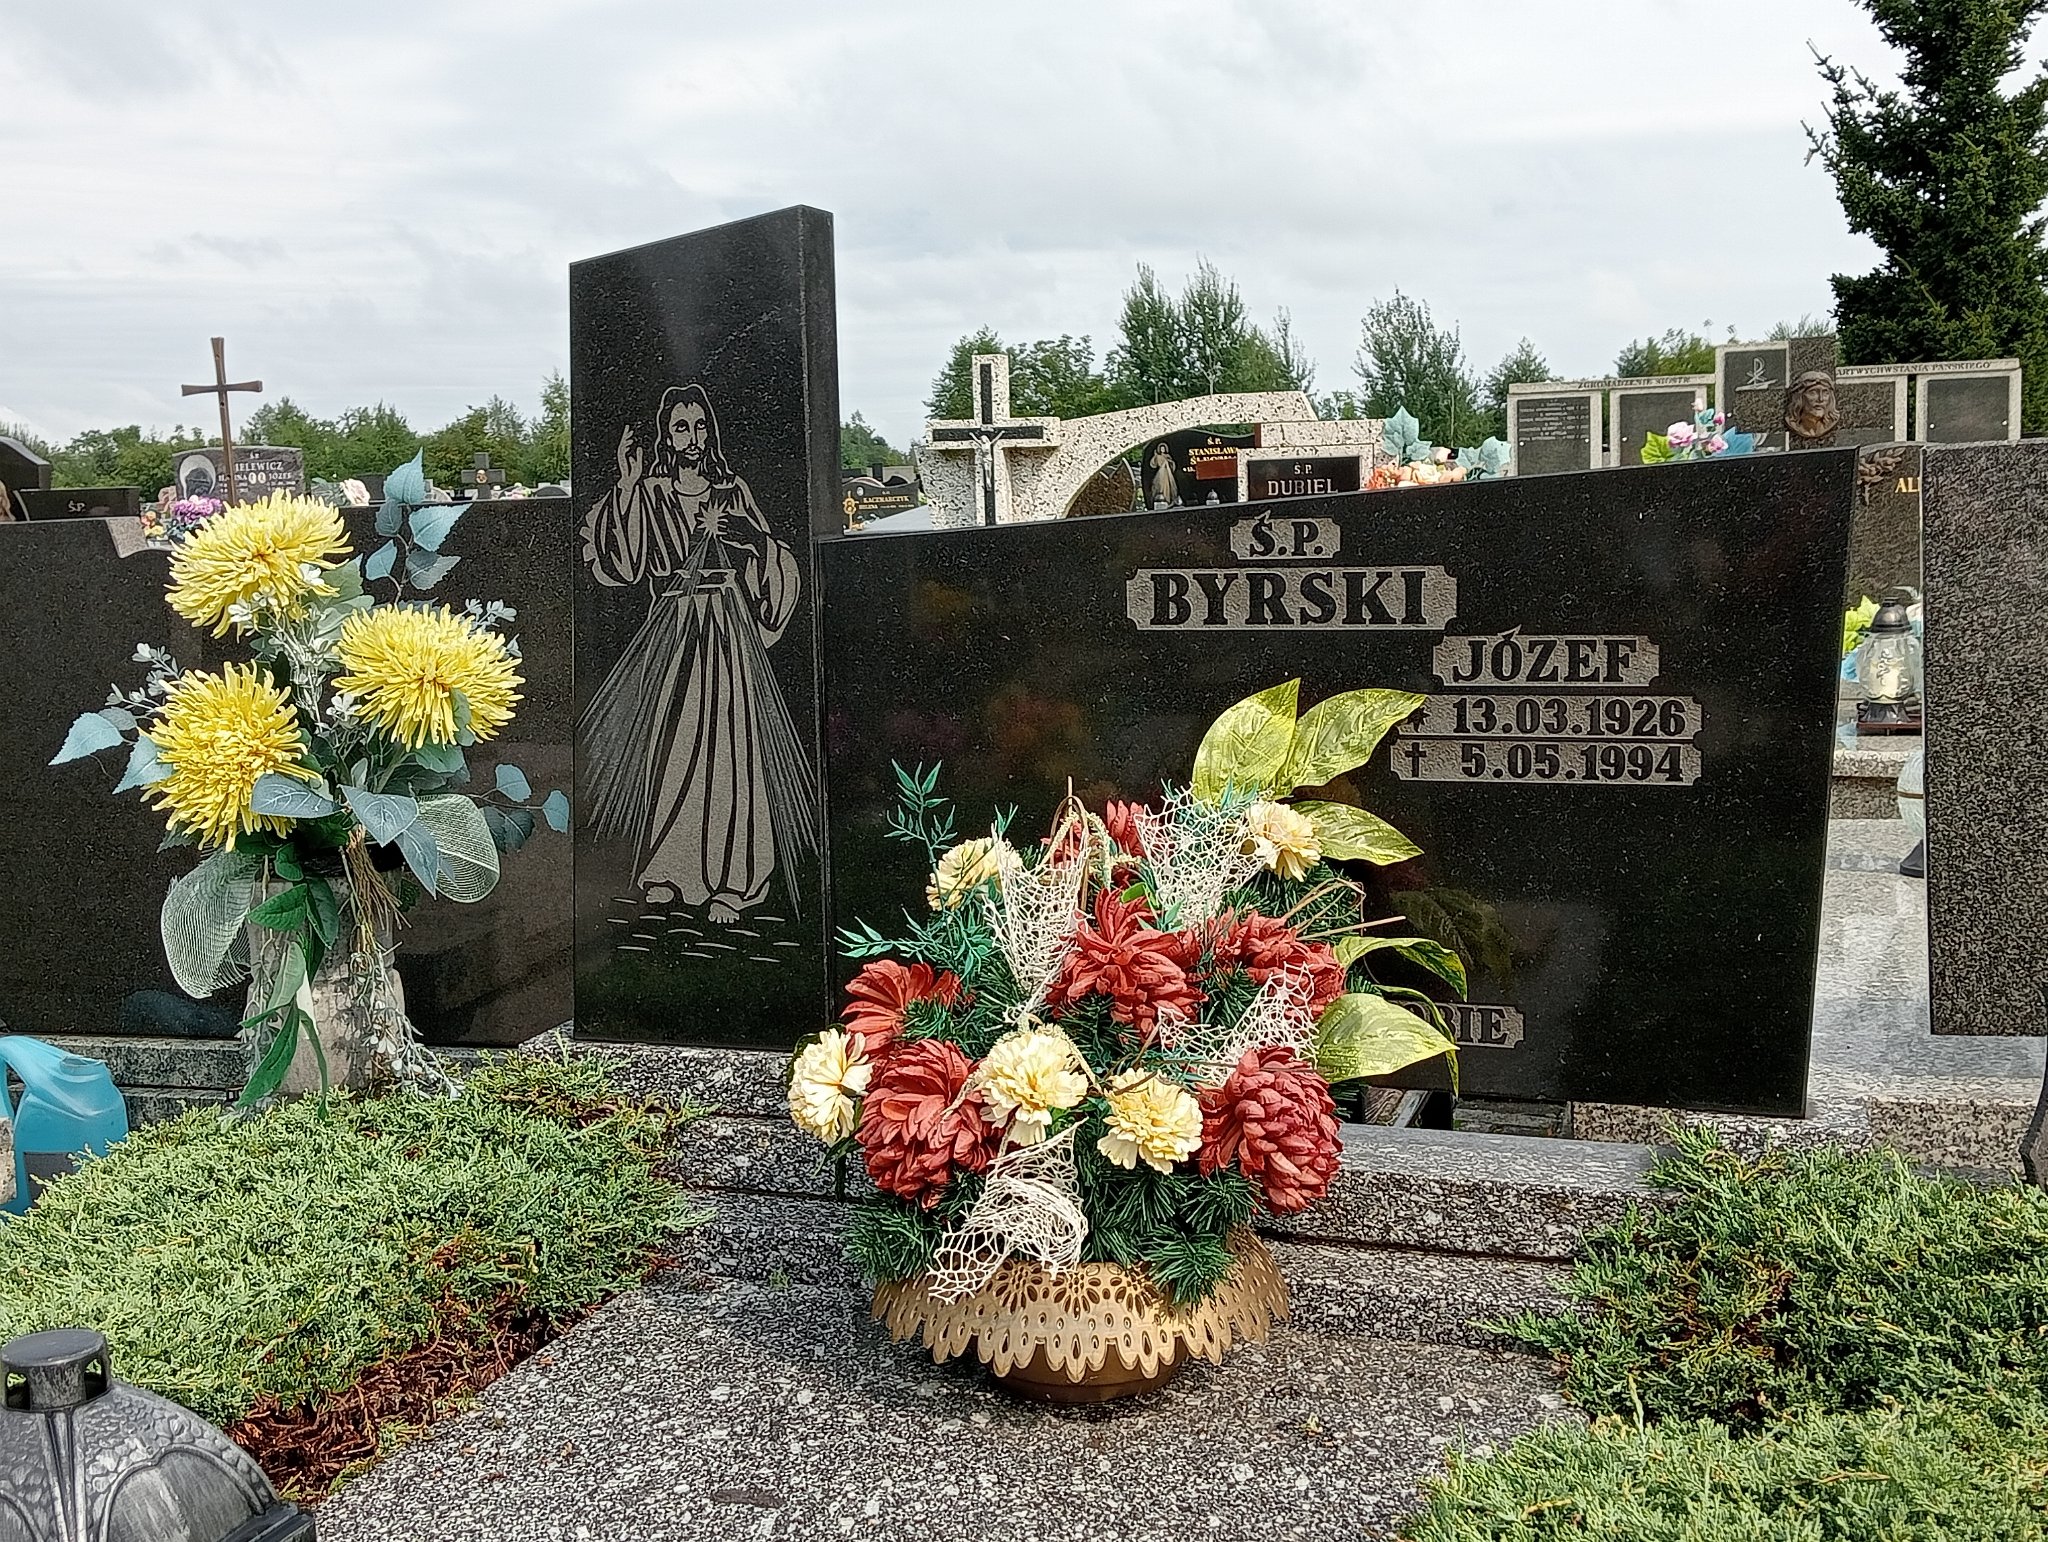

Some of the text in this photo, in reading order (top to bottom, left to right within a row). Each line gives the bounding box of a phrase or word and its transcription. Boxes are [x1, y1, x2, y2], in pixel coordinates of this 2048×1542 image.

[1267, 478, 1338, 496] DUBIEL
[1249, 510, 1323, 557] Ś.P.
[1149, 570, 1427, 626] BYRSKI
[1452, 625, 1638, 683] JÓZEF
[1452, 698, 1687, 736] 13.03.1926
[1461, 743, 1685, 781] 5.05.1994
